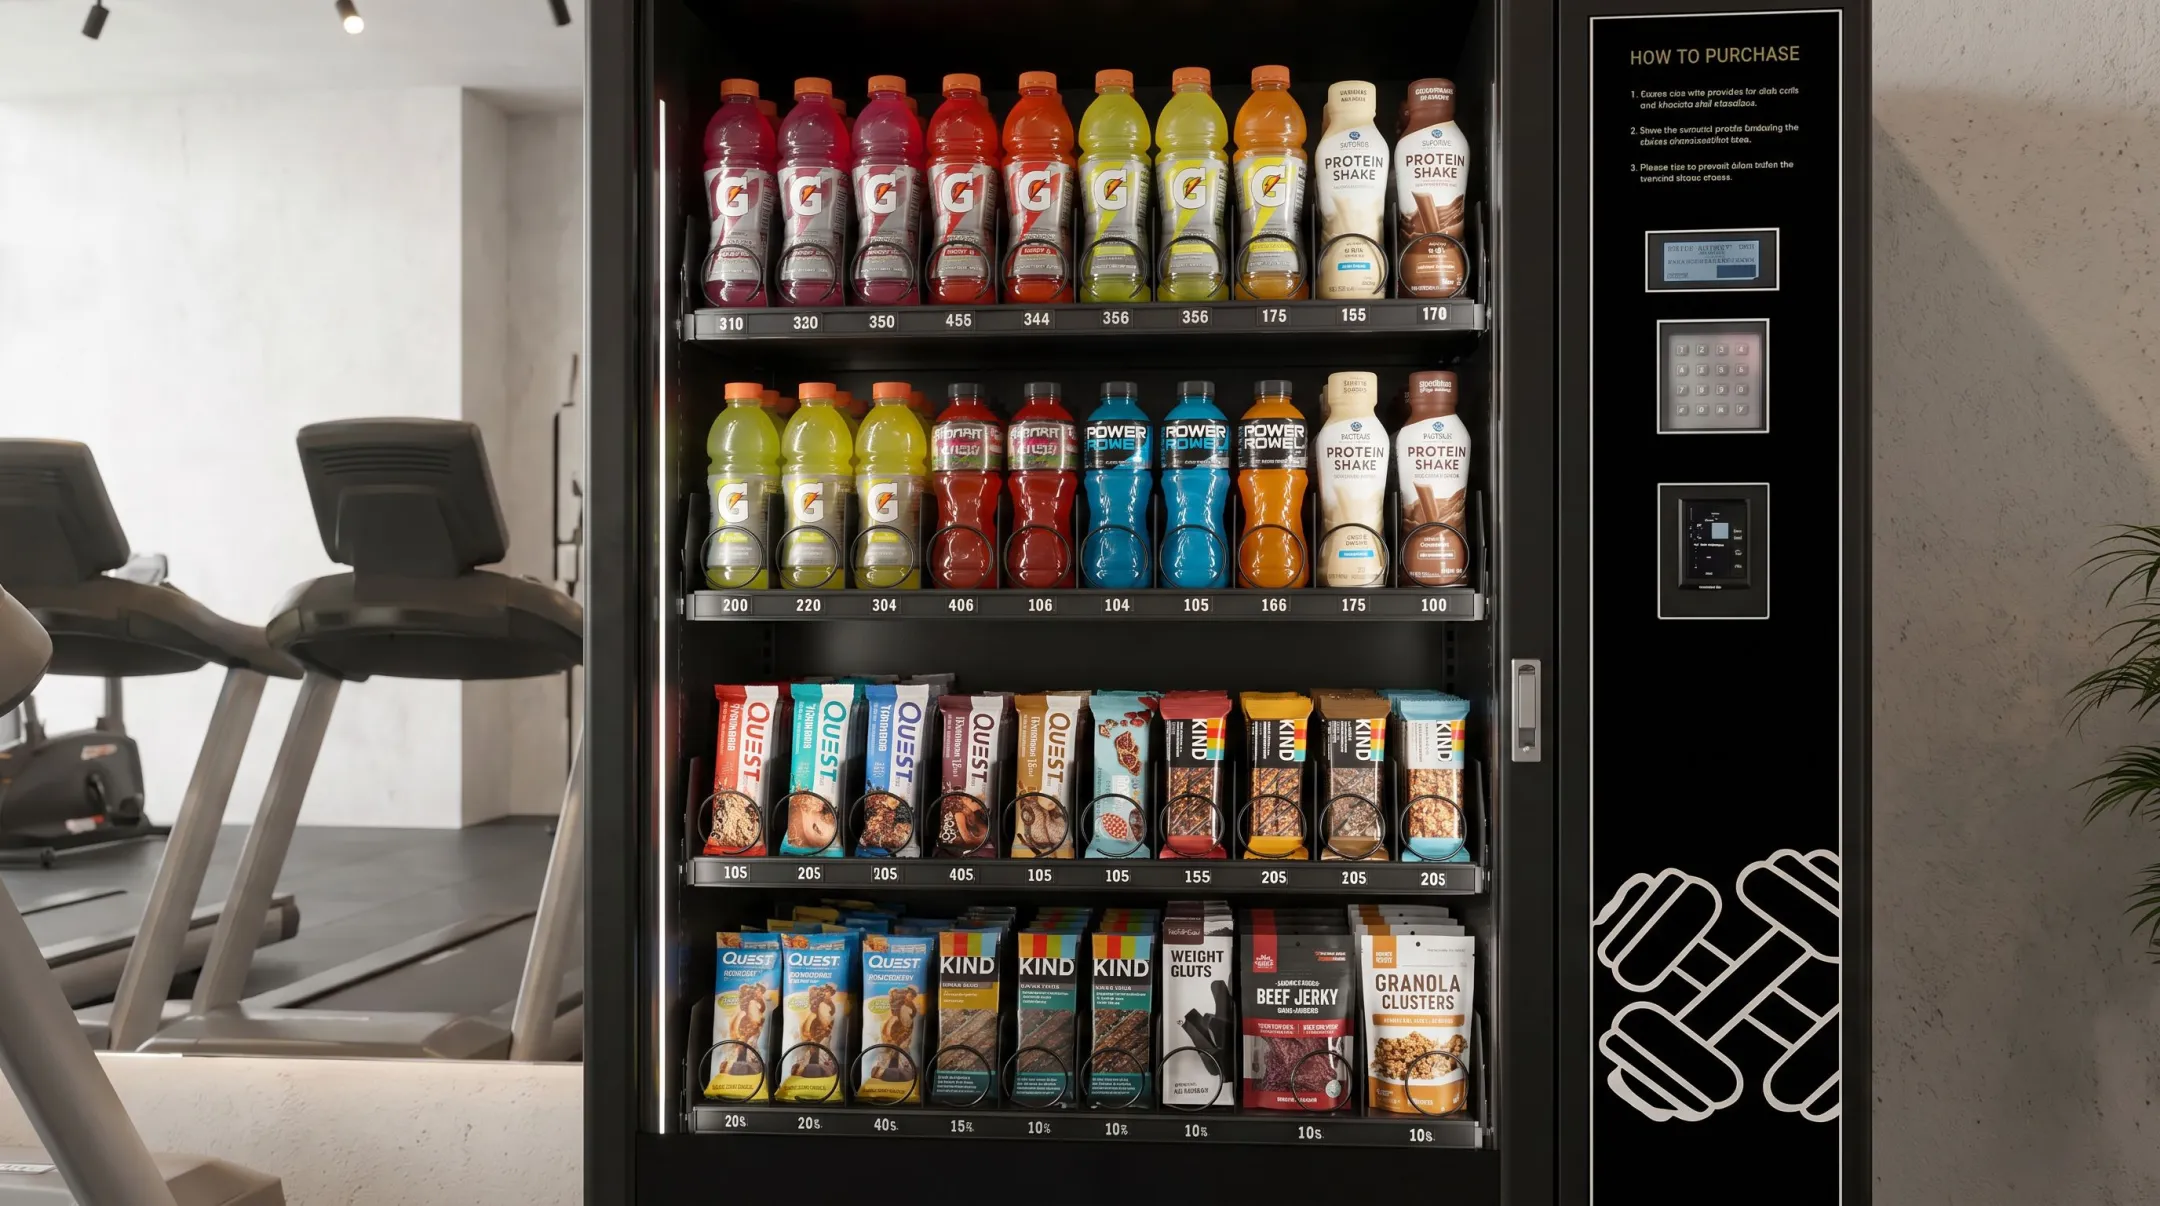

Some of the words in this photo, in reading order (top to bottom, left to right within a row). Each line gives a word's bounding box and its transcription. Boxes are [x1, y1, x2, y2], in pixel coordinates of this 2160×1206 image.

[1630, 49, 1671, 65] HOW
[1676, 48, 1700, 64] TO
[1706, 45, 1800, 63] PURCHASE
[1664, 125, 1678, 134] the
[1785, 123, 1799, 131] the
[1326, 155, 1384, 169] PROTEIN
[1406, 153, 1465, 167] PROTEIN
[1780, 160, 1794, 168] the
[1333, 169, 1376, 181] SHAKE
[1414, 167, 1458, 179] SHAKE
[941, 172, 974, 213] G
[1018, 170, 1051, 211] G
[1095, 169, 1128, 211] G
[1173, 167, 1206, 209] G
[1251, 165, 1287, 207] G
[716, 176, 749, 217] G
[790, 175, 822, 216] G
[865, 173, 897, 214] G
[1024, 312, 1050, 326] 344
[1103, 311, 1129, 325] 356
[1182, 310, 1209, 324] 356
[1262, 309, 1287, 323] 175
[1341, 308, 1367, 321] 155
[1422, 307, 1447, 321] 170
[719, 317, 744, 331] 310
[869, 315, 895, 328] 350
[1087, 425, 1147, 439] POWER
[1244, 424, 1305, 438] POWER
[1327, 446, 1384, 458] PROTEIN
[1407, 446, 1466, 457] PROTEIN
[1334, 459, 1377, 471] SHAKE
[1415, 458, 1459, 470] SHAKE
[717, 481, 749, 523] G
[792, 481, 824, 523] G
[867, 481, 899, 523] G
[723, 598, 748, 612] 200
[796, 598, 821, 612] 220
[872, 598, 897, 612] 304
[948, 598, 974, 612] 406
[1028, 598, 1053, 612] 106
[1105, 598, 1130, 612] 104
[1183, 598, 1209, 612] 105
[1261, 598, 1287, 612] 166
[1341, 598, 1366, 612] 175
[1421, 598, 1447, 611] 100
[743, 701, 770, 782] QUEST
[819, 700, 847, 782] QUEST
[895, 701, 922, 783] QUEST
[1191, 718, 1208, 760] KIND
[1279, 719, 1295, 761] KIND
[1355, 719, 1372, 761] KIND
[1436, 720, 1452, 762] KIND
[971, 713, 995, 783] QUEST
[1046, 712, 1071, 784] QUEST
[722, 951, 774, 966] QUEST
[788, 952, 840, 968] QUEST
[868, 954, 921, 969] QUEST
[1171, 950, 1224, 963] WEIGHT
[939, 956, 995, 975] KIND
[1019, 957, 1075, 976] KIND
[1093, 959, 1149, 978] KIND
[1171, 964, 1212, 978] GLUTS
[1375, 973, 1460, 992] GRANOLA
[1256, 987, 1290, 1005] BEEF
[1294, 988, 1339, 1006] JERKY
[1382, 994, 1455, 1010] CLUSTERS
